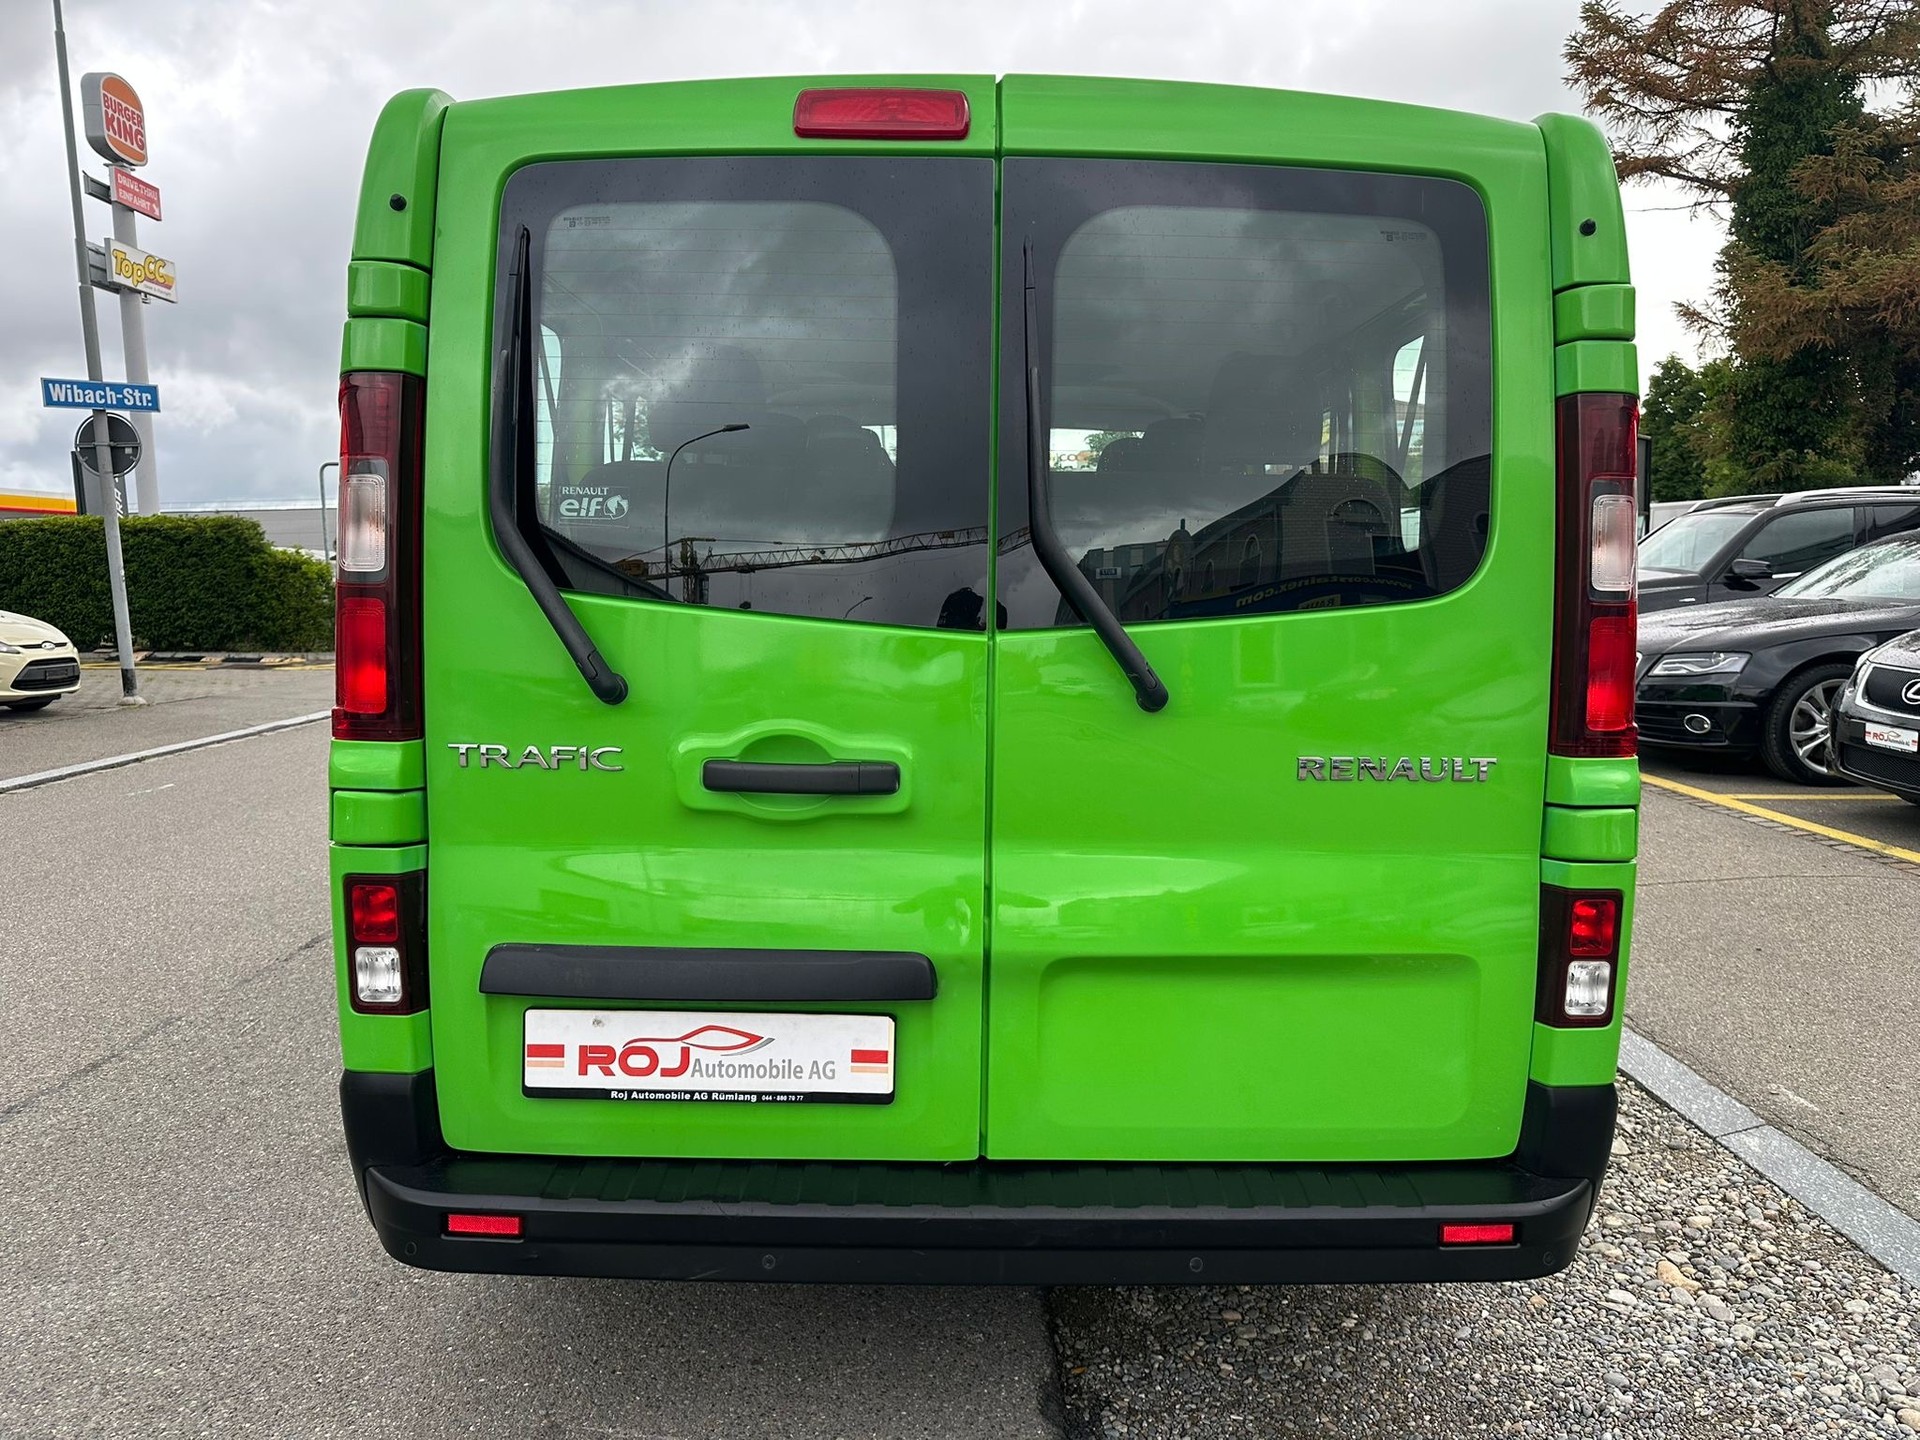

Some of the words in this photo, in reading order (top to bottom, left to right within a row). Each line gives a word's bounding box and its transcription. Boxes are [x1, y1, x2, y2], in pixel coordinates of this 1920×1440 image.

[102, 93, 143, 128] BURGER
[104, 110, 145, 151] KING
[112, 249, 166, 286] TopCC
[48, 383, 152, 406] Wibach-Str.
[562, 486, 609, 495] RENAULT
[559, 497, 603, 517] elf
[1872, 732, 1888, 741] ROJ
[448, 743, 624, 771] TRAFIC
[1296, 756, 1498, 782] RENAULT
[578, 1044, 690, 1077] ROJ
[690, 1058, 804, 1080] Automobile
[808, 1060, 836, 1080] AG
[610, 1091, 628, 1101] Roj
[631, 1091, 691, 1100] Automobile
[693, 1092, 708, 1100] AG
[711, 1092, 757, 1102] Rümlang
